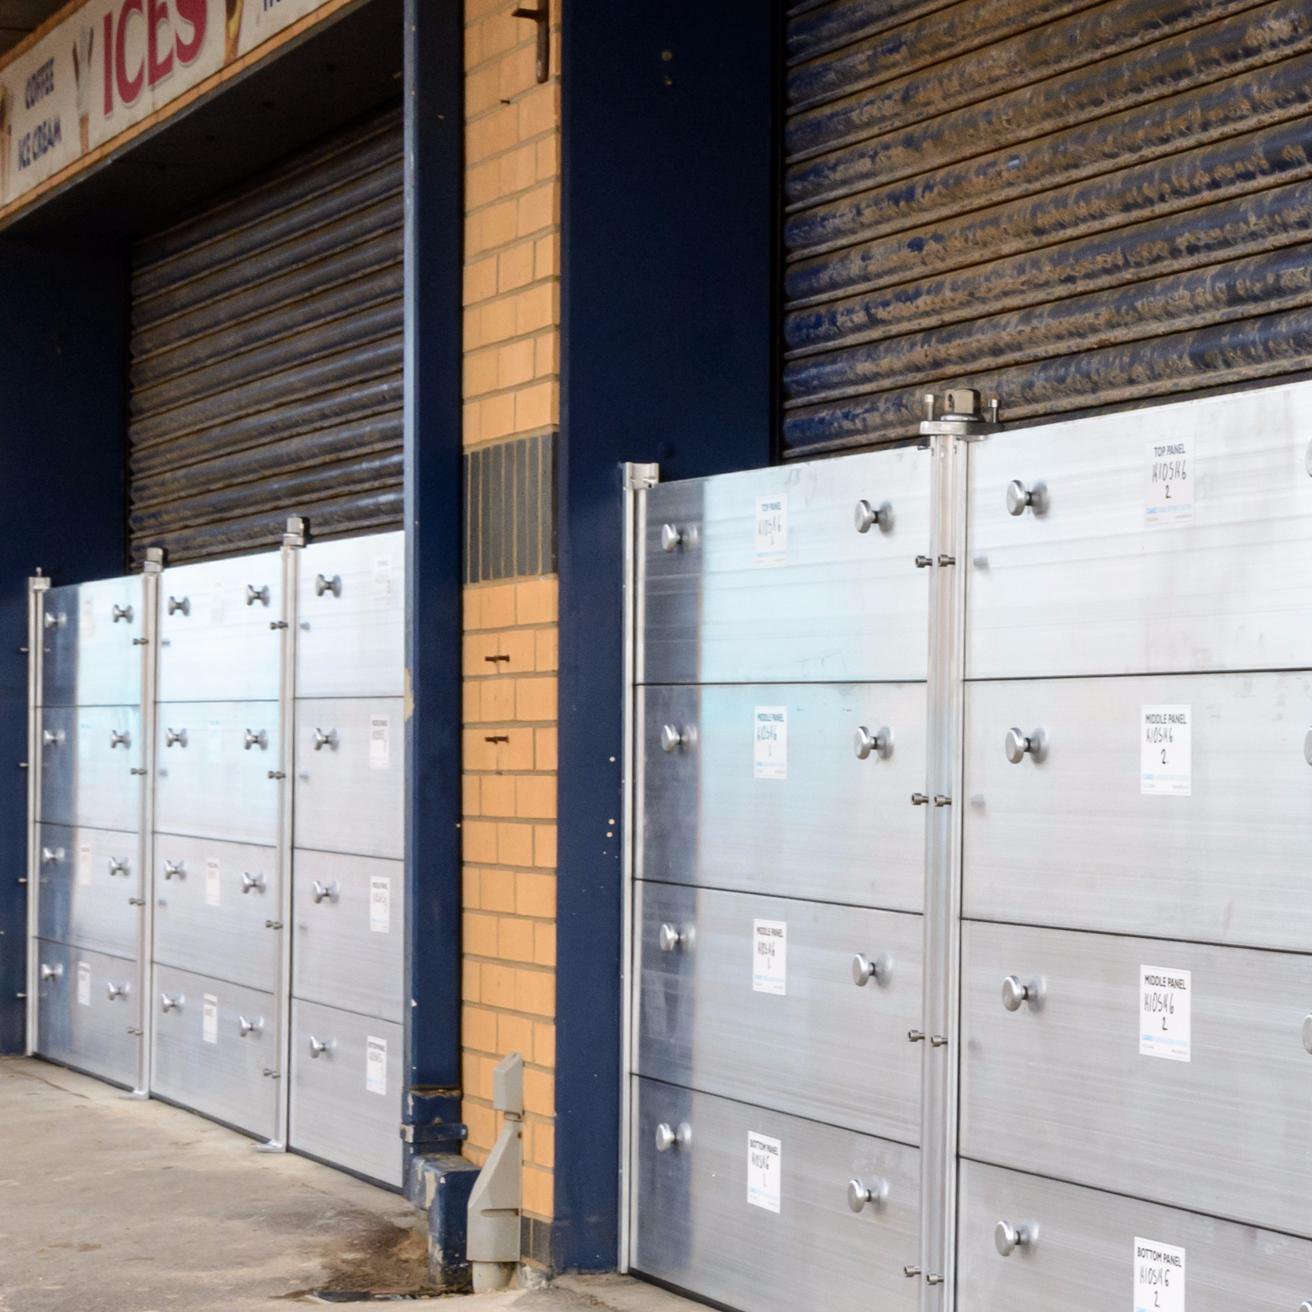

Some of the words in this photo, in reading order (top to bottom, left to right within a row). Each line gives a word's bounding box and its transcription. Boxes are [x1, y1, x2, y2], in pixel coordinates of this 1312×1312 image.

[103, 0, 208, 117] ICES
[25, 57, 55, 109] COFFEE
[18, 132, 30, 171] ICE
[33, 115, 61, 160] CREAM
[1154, 446, 1166, 457] TOP
[1167, 443, 1186, 455] PANEL
[1145, 713, 1167, 724] MIDDLE
[1168, 713, 1187, 725] PANEL
[1144, 974, 1167, 987] MIDDLE
[1167, 977, 1186, 990] PANEL
